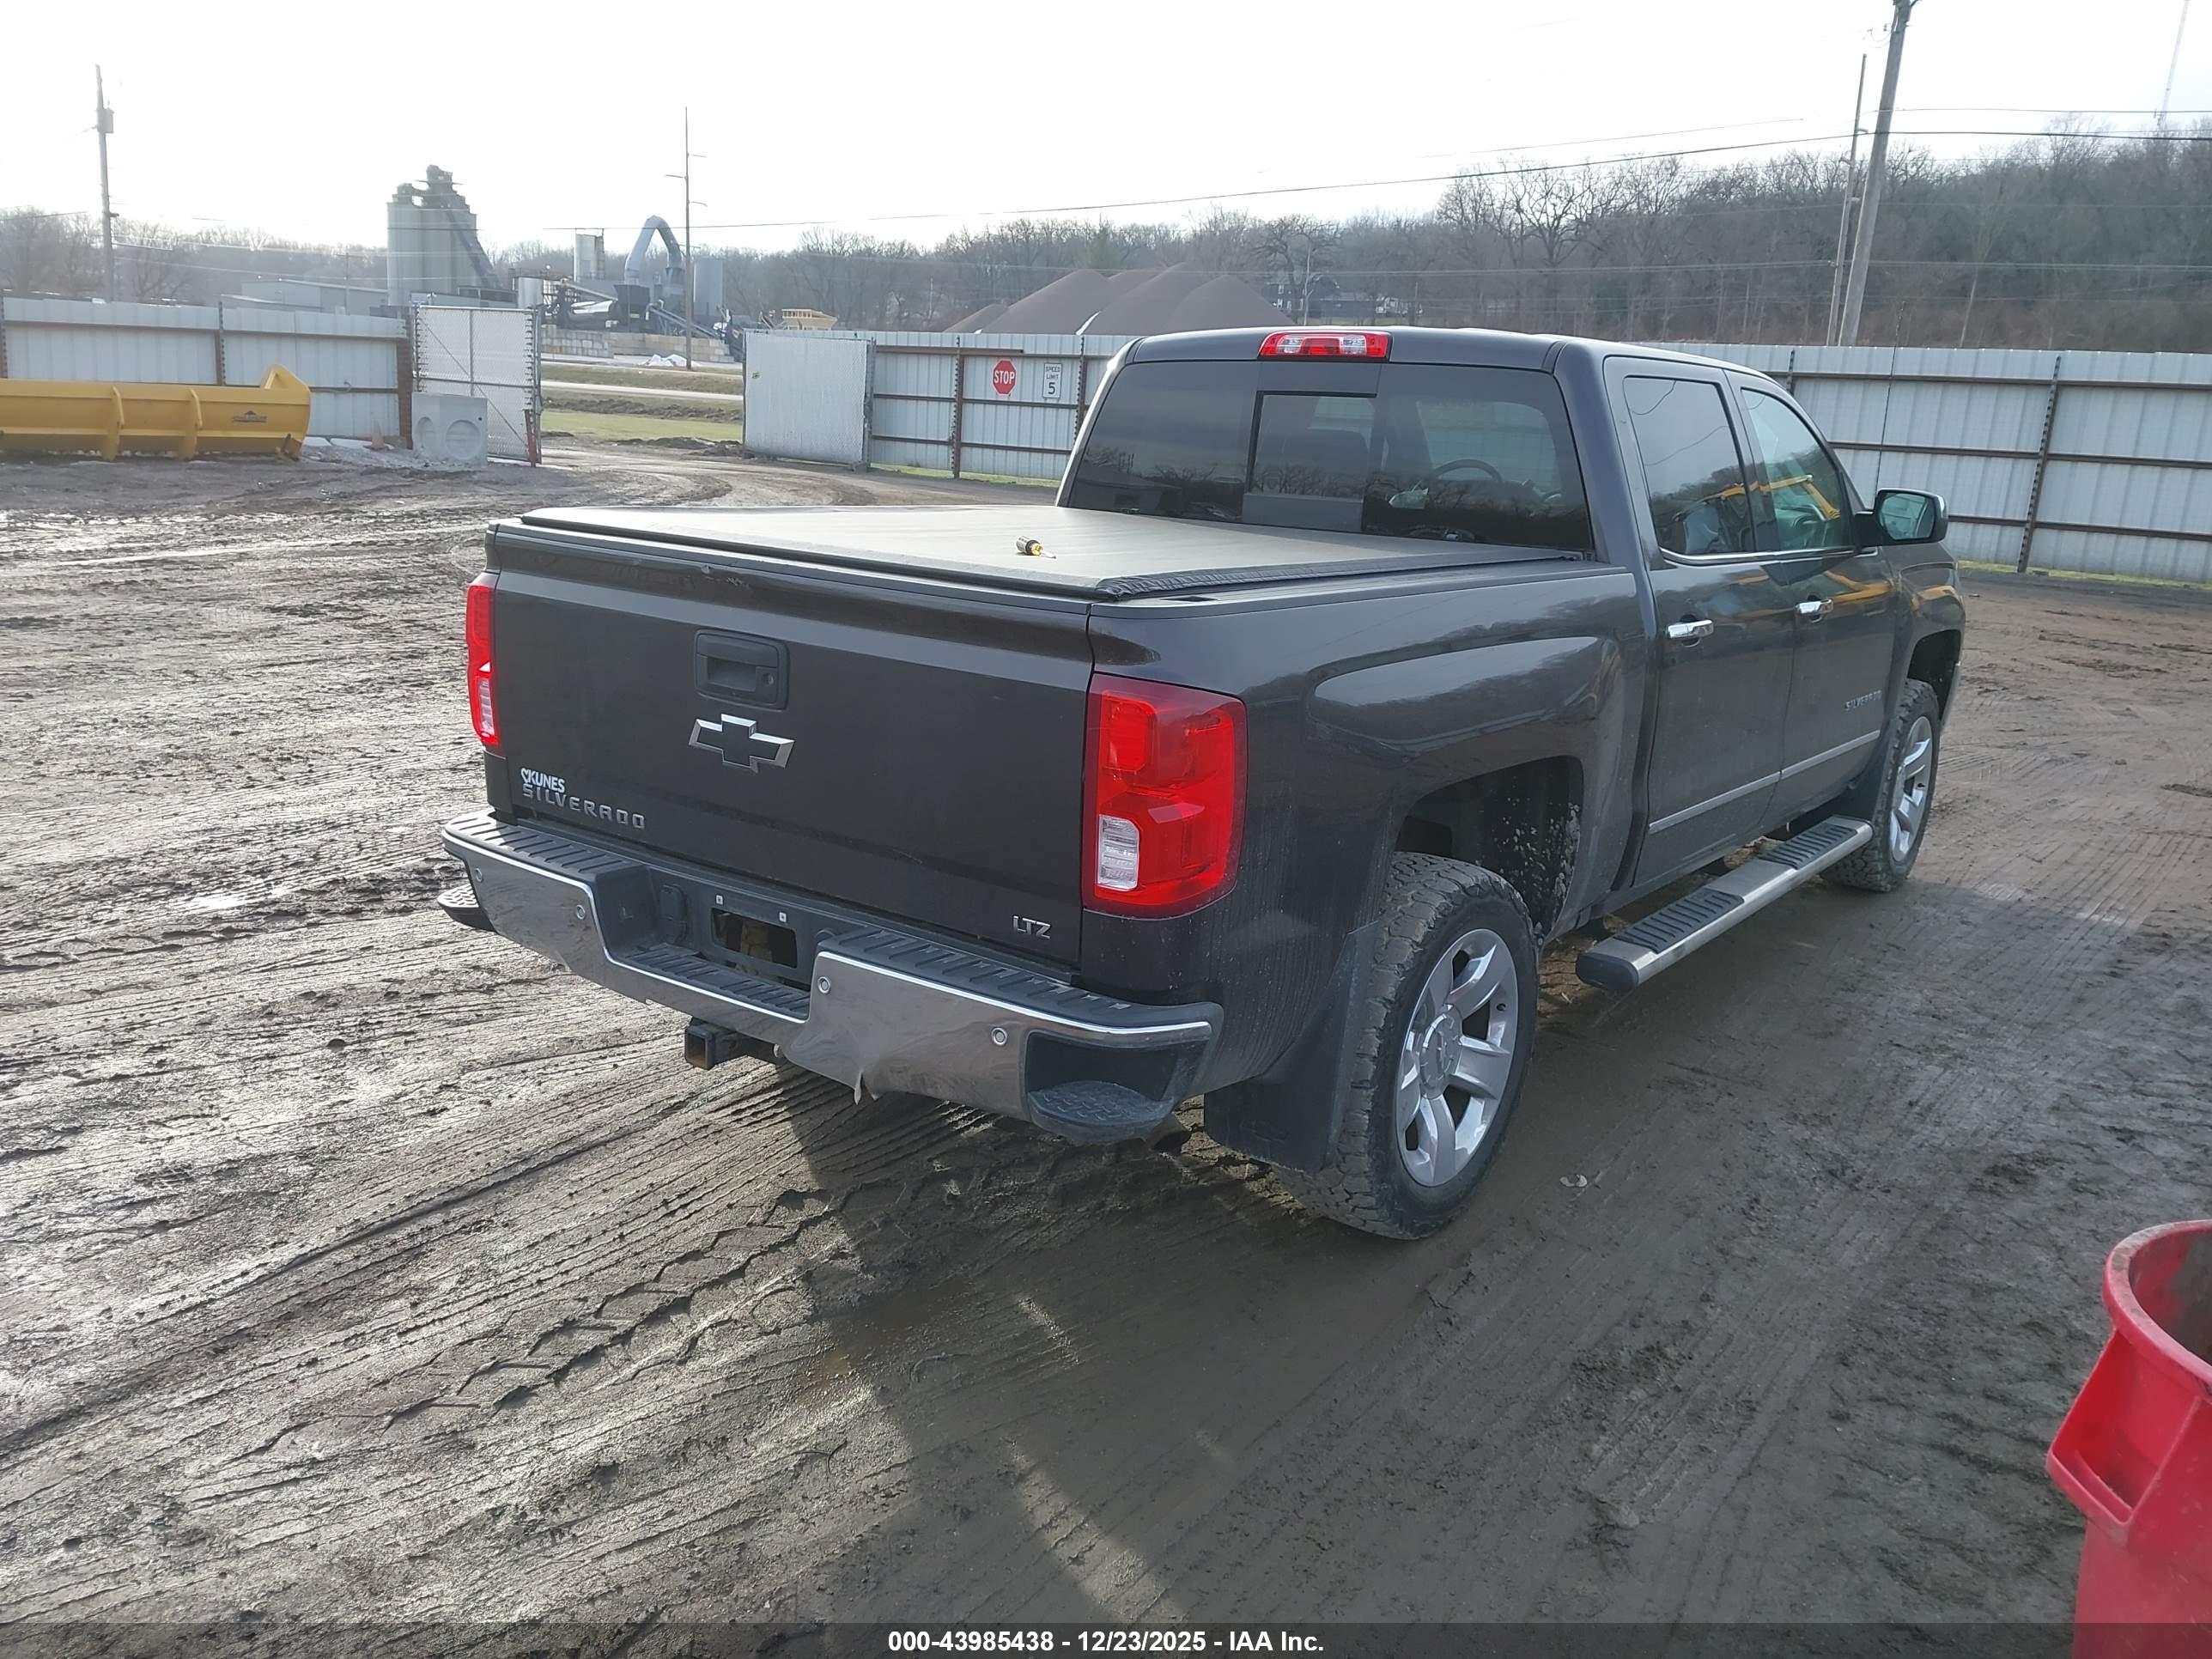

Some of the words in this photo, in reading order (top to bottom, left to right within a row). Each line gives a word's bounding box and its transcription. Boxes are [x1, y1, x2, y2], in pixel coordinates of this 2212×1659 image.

[994, 370, 1015, 385] STOP
[1048, 382, 1056, 395] 5
[528, 769, 566, 793] KUNES
[522, 782, 645, 830] SILVERADO
[1013, 915, 1051, 939] LTZ
